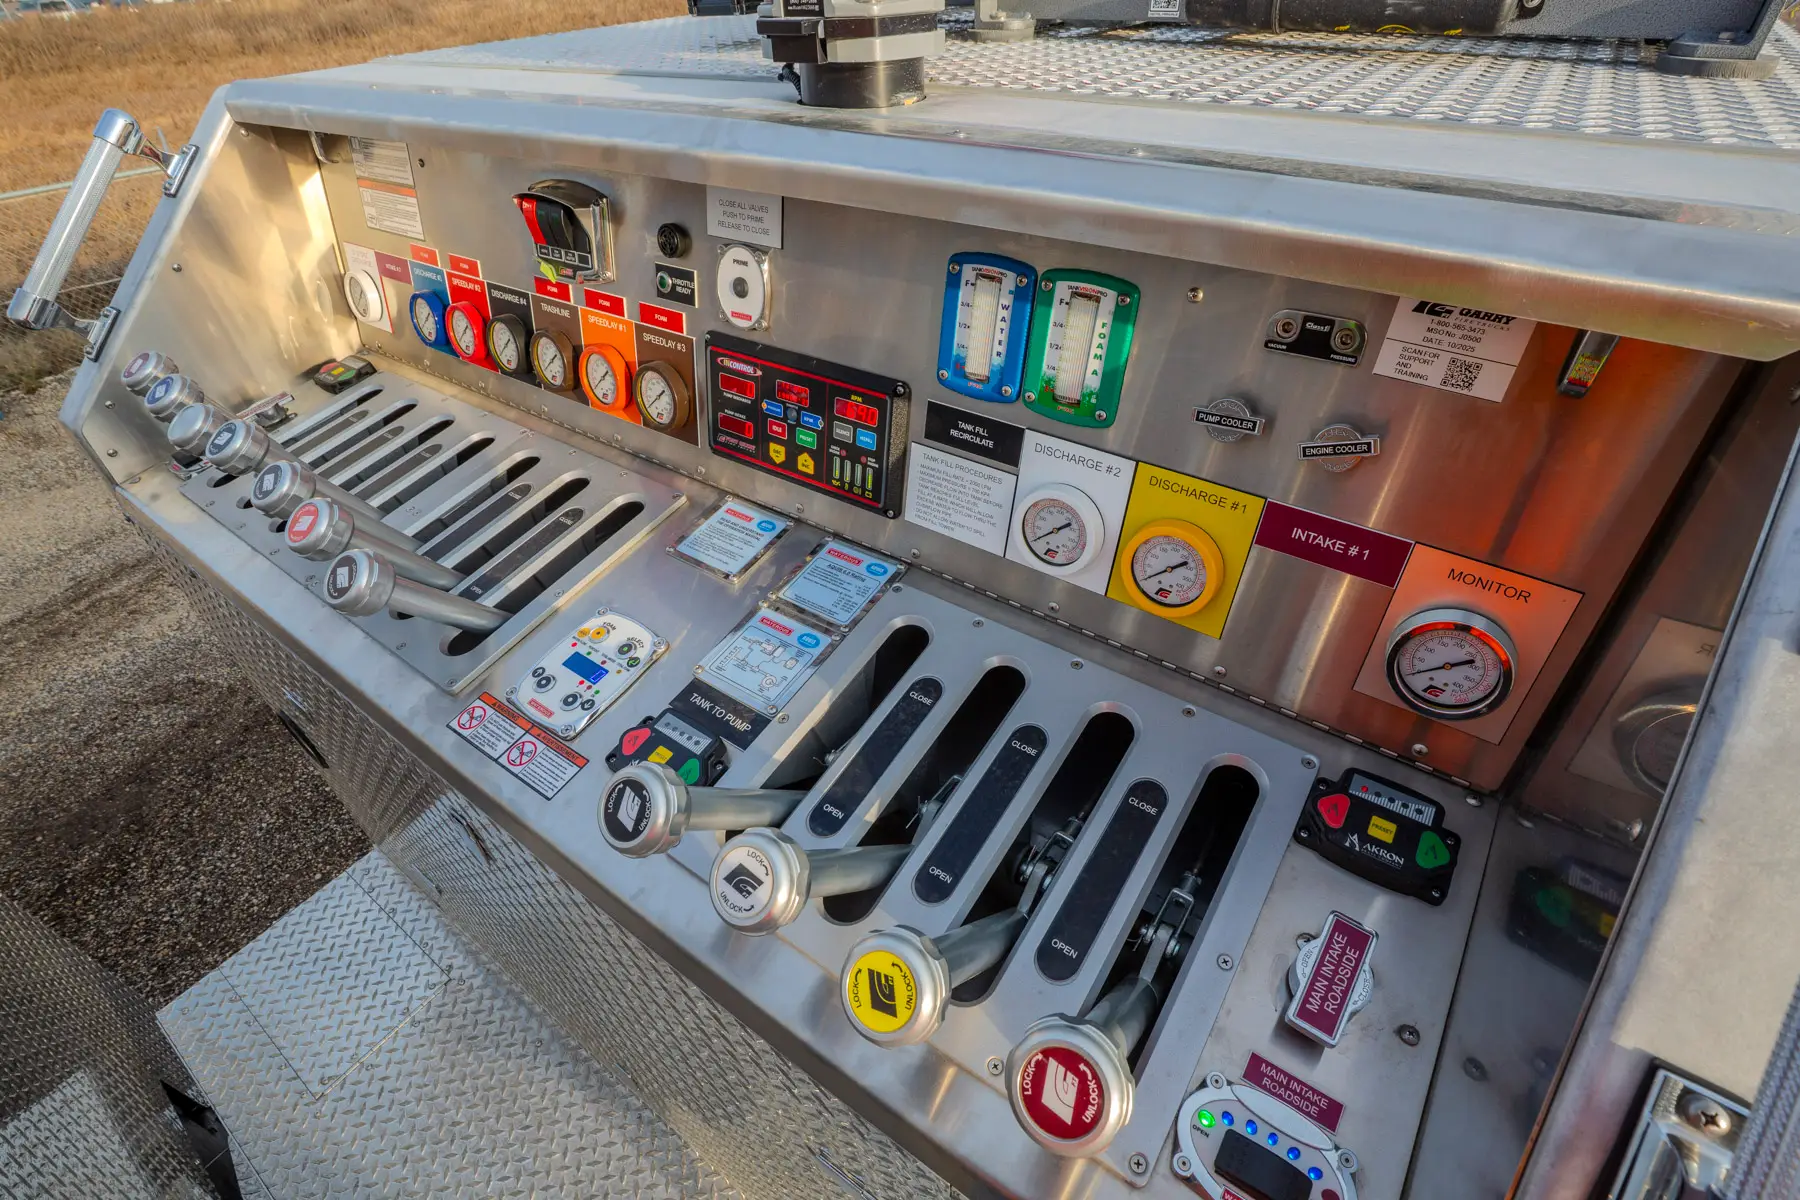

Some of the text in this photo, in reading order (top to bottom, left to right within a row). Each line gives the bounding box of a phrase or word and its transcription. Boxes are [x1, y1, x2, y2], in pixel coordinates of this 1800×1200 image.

[718, 199, 769, 214] CLOSE ALL VALVES
[722, 211, 764, 224] PUSH TO PRIME
[717, 220, 770, 236] RELEASE TO CLOSE
[732, 258, 749, 268] PRIME
[452, 277, 475, 290] SPEEDLAY
[672, 278, 695, 289] THROTTLE
[675, 285, 692, 296] READY
[491, 288, 527, 306] DISCHARGE #4
[598, 299, 611, 308] FOAM
[540, 302, 571, 319] TRASHLINE
[654, 313, 668, 323] FOAM
[588, 314, 627, 333] SPEEDLAY #1
[1430, 319, 1486, 335] 1-800-565-3473
[642, 332, 686, 353] SPEEDLAY #3
[1426, 327, 1482, 344] MSO J0500
[1267, 342, 1287, 350] VACUUM
[1402, 346, 1441, 360] SCAN FOR
[1422, 336, 1476, 353] DATE: 10/2025
[1330, 353, 1356, 363] PRESSURE
[1395, 361, 1412, 370] AND
[1399, 353, 1435, 367] SUPPORT
[1394, 367, 1429, 381] TRAINING
[957, 420, 989, 437] TANK FILL
[1198, 413, 1254, 430] PUMP COOLER
[950, 428, 994, 449] RECIRCULATE
[1305, 444, 1368, 456] ENGINE COOLER
[922, 452, 1003, 485] TANK FILL PROCEDURES
[1034, 442, 1122, 478] DISCHARGE #2
[1149, 475, 1248, 514] DISCHARGE #1
[559, 516, 574, 526] CLOSE
[1291, 526, 1346, 555] INTAKE
[470, 585, 484, 595] OPEN
[1448, 568, 1532, 604] MONITOR
[603, 621, 616, 631] FOAM
[626, 636, 644, 649] SELECT
[1424, 646, 1435, 654] 100
[1437, 640, 1449, 648] 150
[1453, 642, 1466, 650] 200
[1465, 651, 1477, 659] 250
[1468, 664, 1480, 672] 300
[1452, 682, 1464, 690] 400
[909, 691, 933, 706] CLOSE
[689, 693, 752, 732] TANK TO PUMP
[541, 734, 579, 761] AVERTISSEMENT
[1011, 740, 1038, 757] CLOSE
[608, 793, 617, 813] LOCK
[823, 803, 845, 820] OPEN
[1128, 796, 1158, 816] CLOSE
[638, 800, 651, 831] UNLOCK
[747, 850, 765, 867] LOCK
[1363, 843, 1405, 865] AKRON
[929, 866, 953, 884] OPEN
[720, 891, 744, 914] UNLOCK
[1051, 938, 1078, 959] OPEN
[1301, 949, 1314, 969] OPEN
[1306, 931, 1347, 1014] MAIN INTAKE
[1324, 947, 1359, 1015] ROADSIDE
[852, 982, 862, 1009] LOCK
[902, 971, 917, 1011] UNLOCK
[1358, 977, 1372, 1003] CLOSE
[1024, 1066, 1035, 1095] LOCK
[1260, 1063, 1329, 1109] MAIN INTAKE
[1082, 1079, 1099, 1123] UNLOCK
[1262, 1078, 1319, 1118] ROADSIDE
